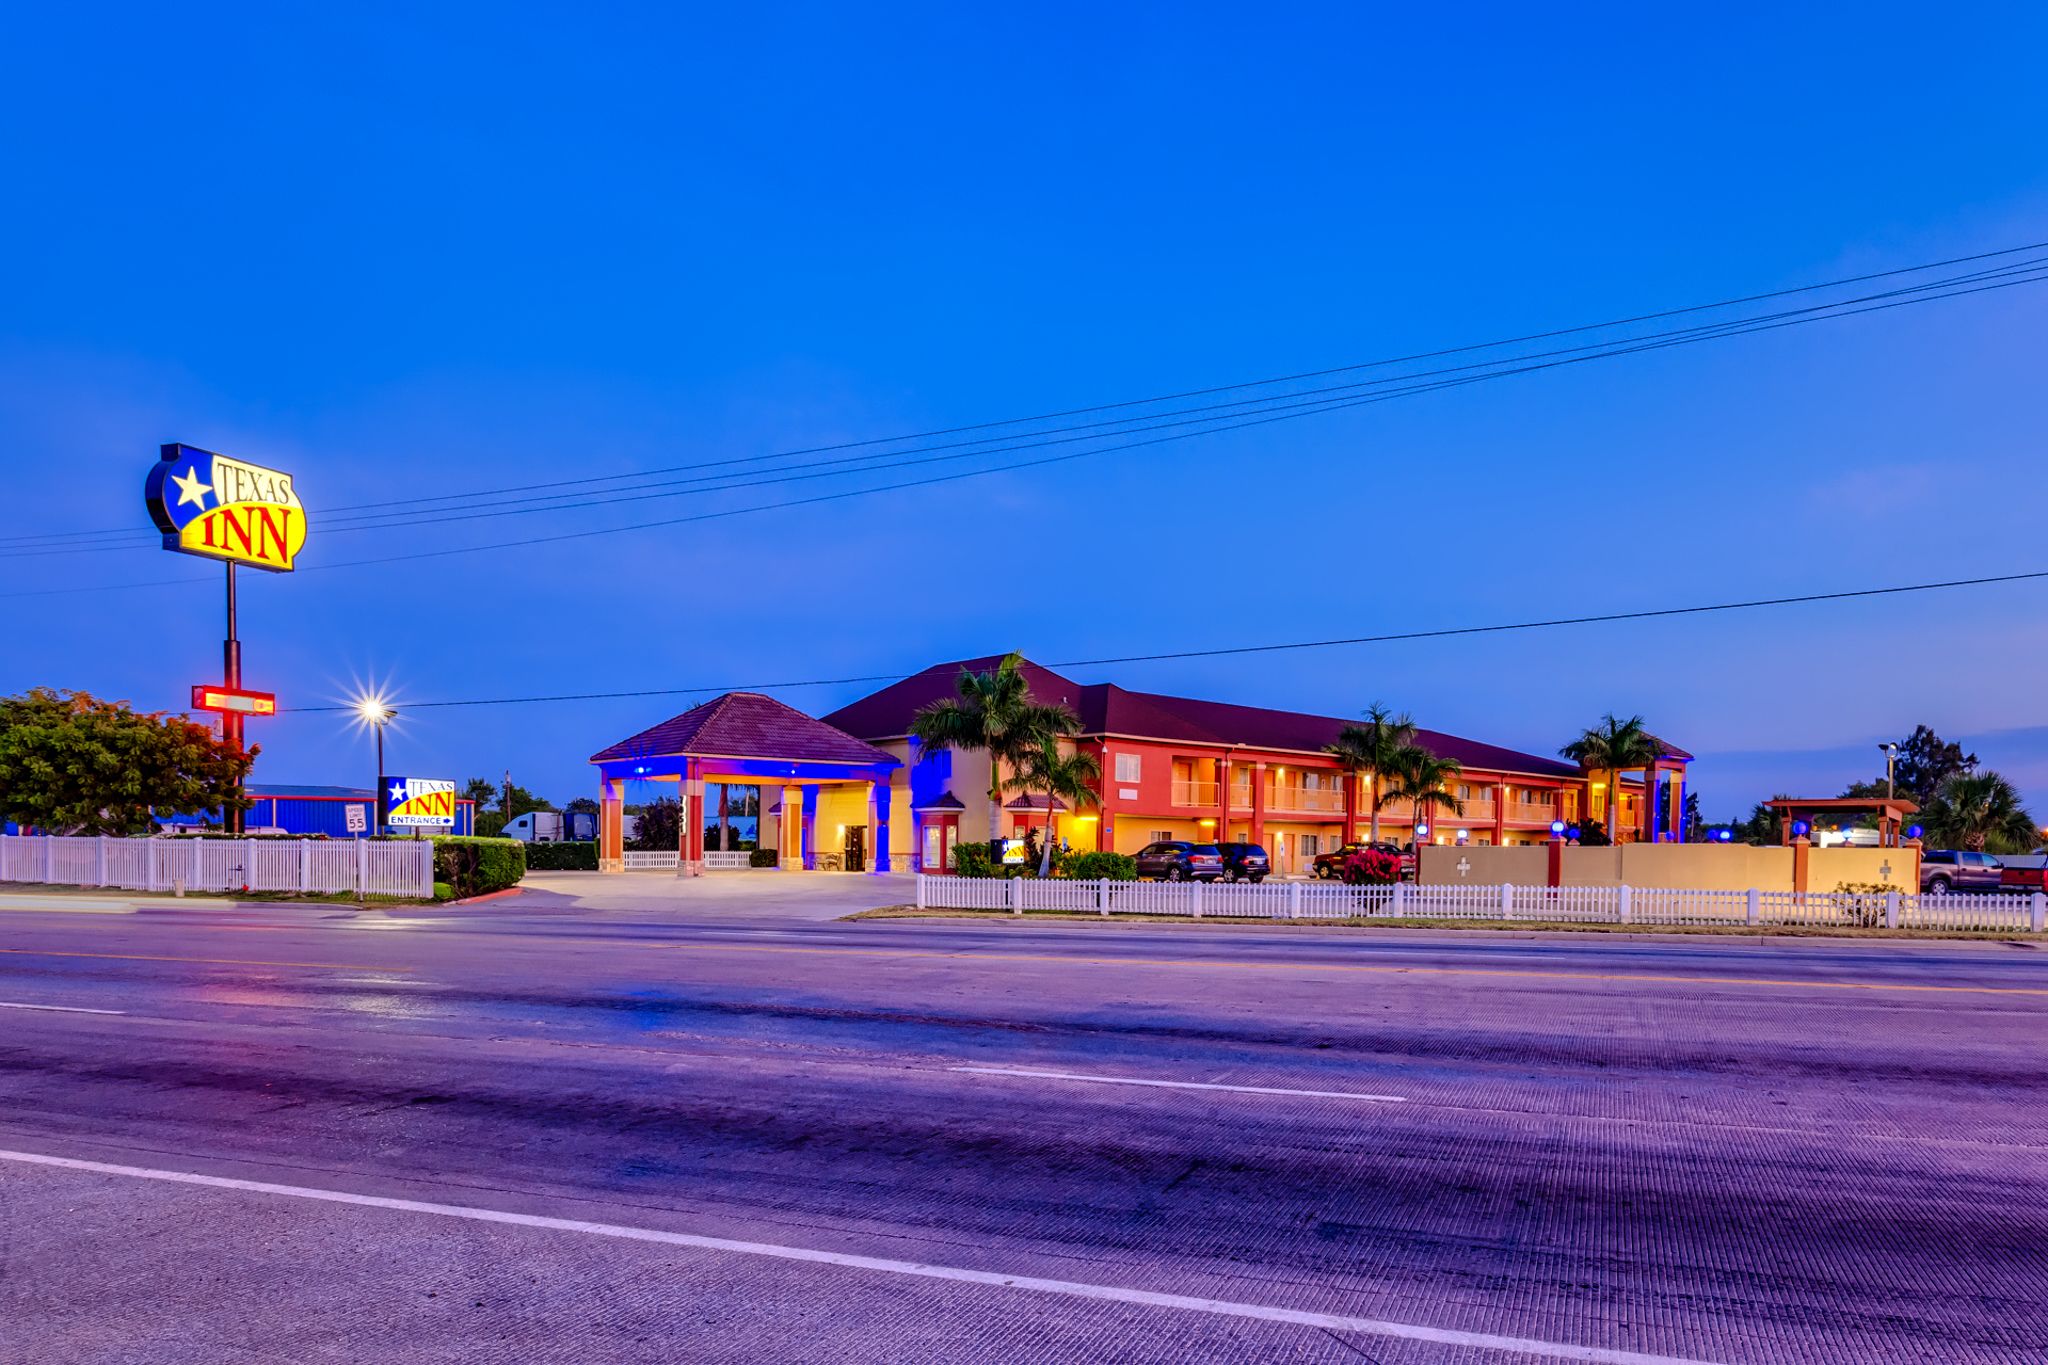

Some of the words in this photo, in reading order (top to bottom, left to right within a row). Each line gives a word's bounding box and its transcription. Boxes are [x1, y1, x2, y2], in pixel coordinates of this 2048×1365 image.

[217, 462, 290, 505] TEXAS
[202, 506, 292, 564] INN
[409, 781, 453, 797] TEXAS
[405, 792, 453, 816] INN
[349, 818, 365, 829] 55
[391, 816, 442, 825] ENTRANCE
